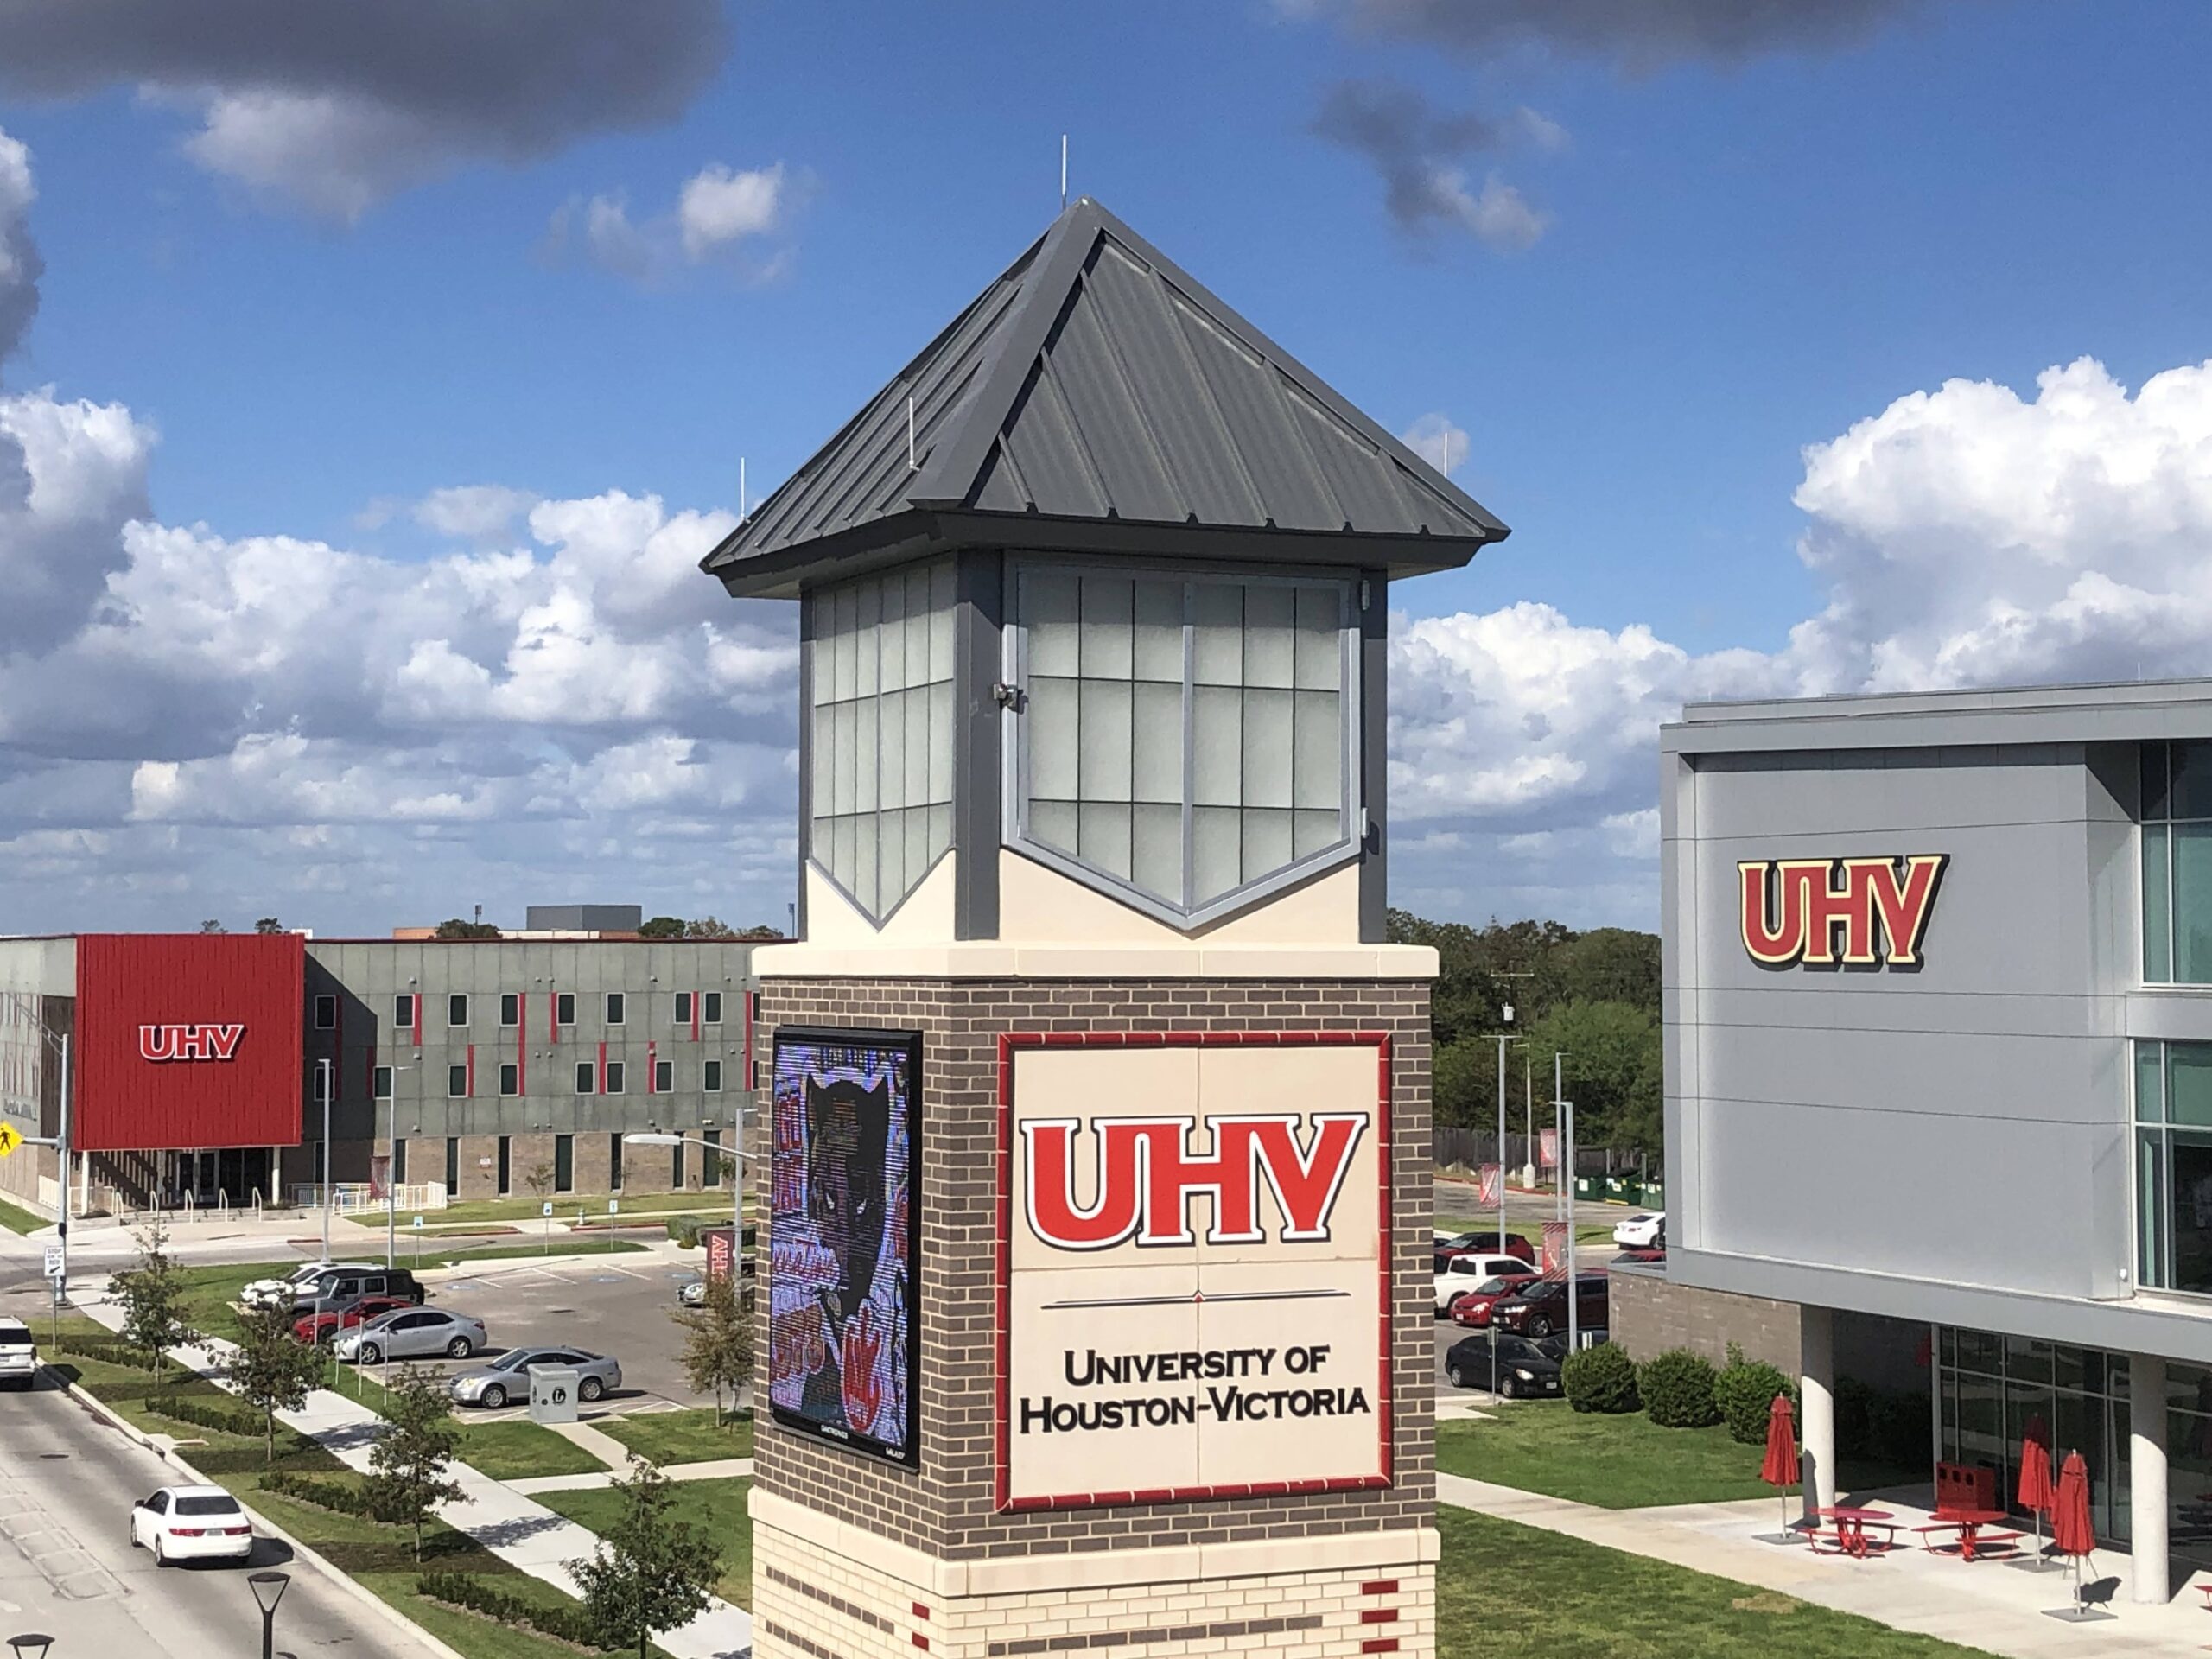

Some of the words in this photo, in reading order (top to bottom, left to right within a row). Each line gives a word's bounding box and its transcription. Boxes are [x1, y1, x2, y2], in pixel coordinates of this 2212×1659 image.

[1738, 855, 1950, 972] UHV
[138, 1024, 245, 1062] UHV
[1020, 1112, 1370, 1252] UHV
[1065, 1350, 1277, 1387] UNIVERSITY
[1284, 1344, 1331, 1373] OF
[1020, 1386, 1371, 1434] HOUSTON-VICTORIA
